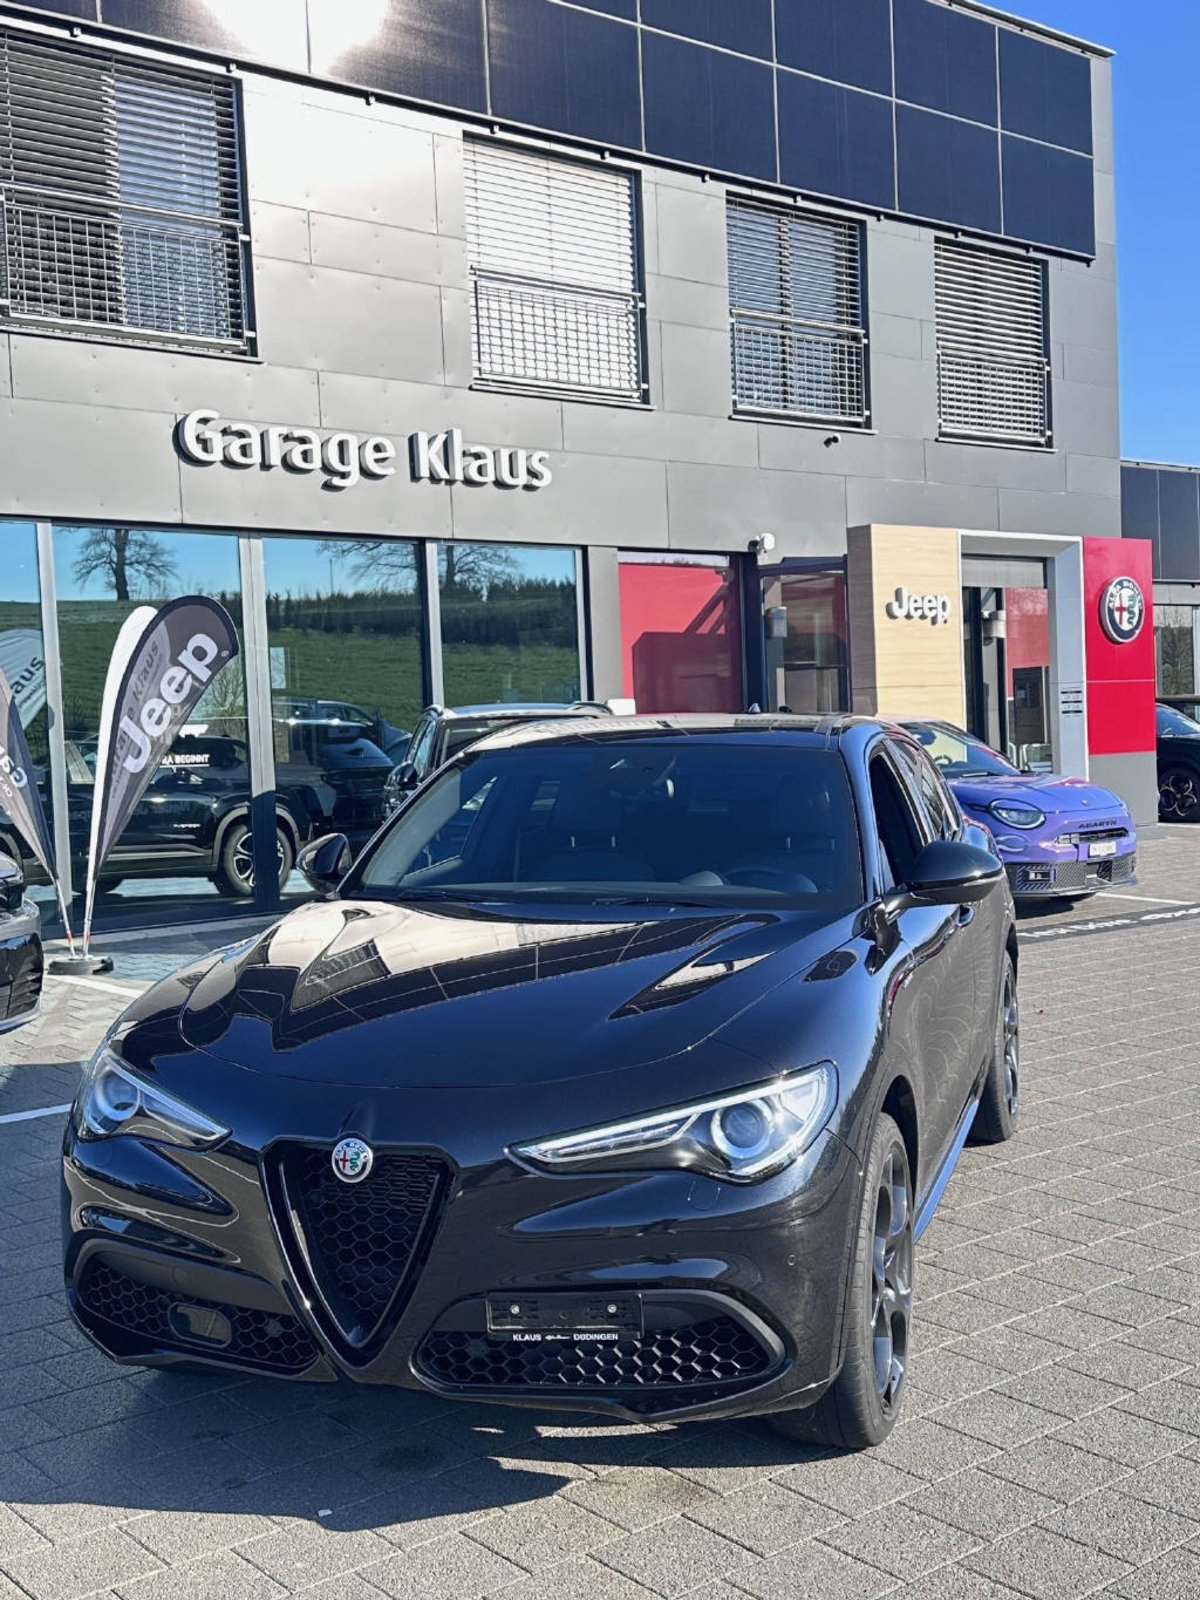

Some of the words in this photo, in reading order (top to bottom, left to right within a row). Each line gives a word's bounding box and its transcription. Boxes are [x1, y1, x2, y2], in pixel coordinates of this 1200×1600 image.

[175, 409, 396, 489] Garage
[410, 428, 552, 489] Klaus
[887, 586, 951, 625] Jeep
[119, 633, 219, 773] Jeep
[174, 753, 210, 764] BEGINNT
[1078, 819, 1118, 829] ABARTH
[512, 1333, 542, 1342] KLAUS
